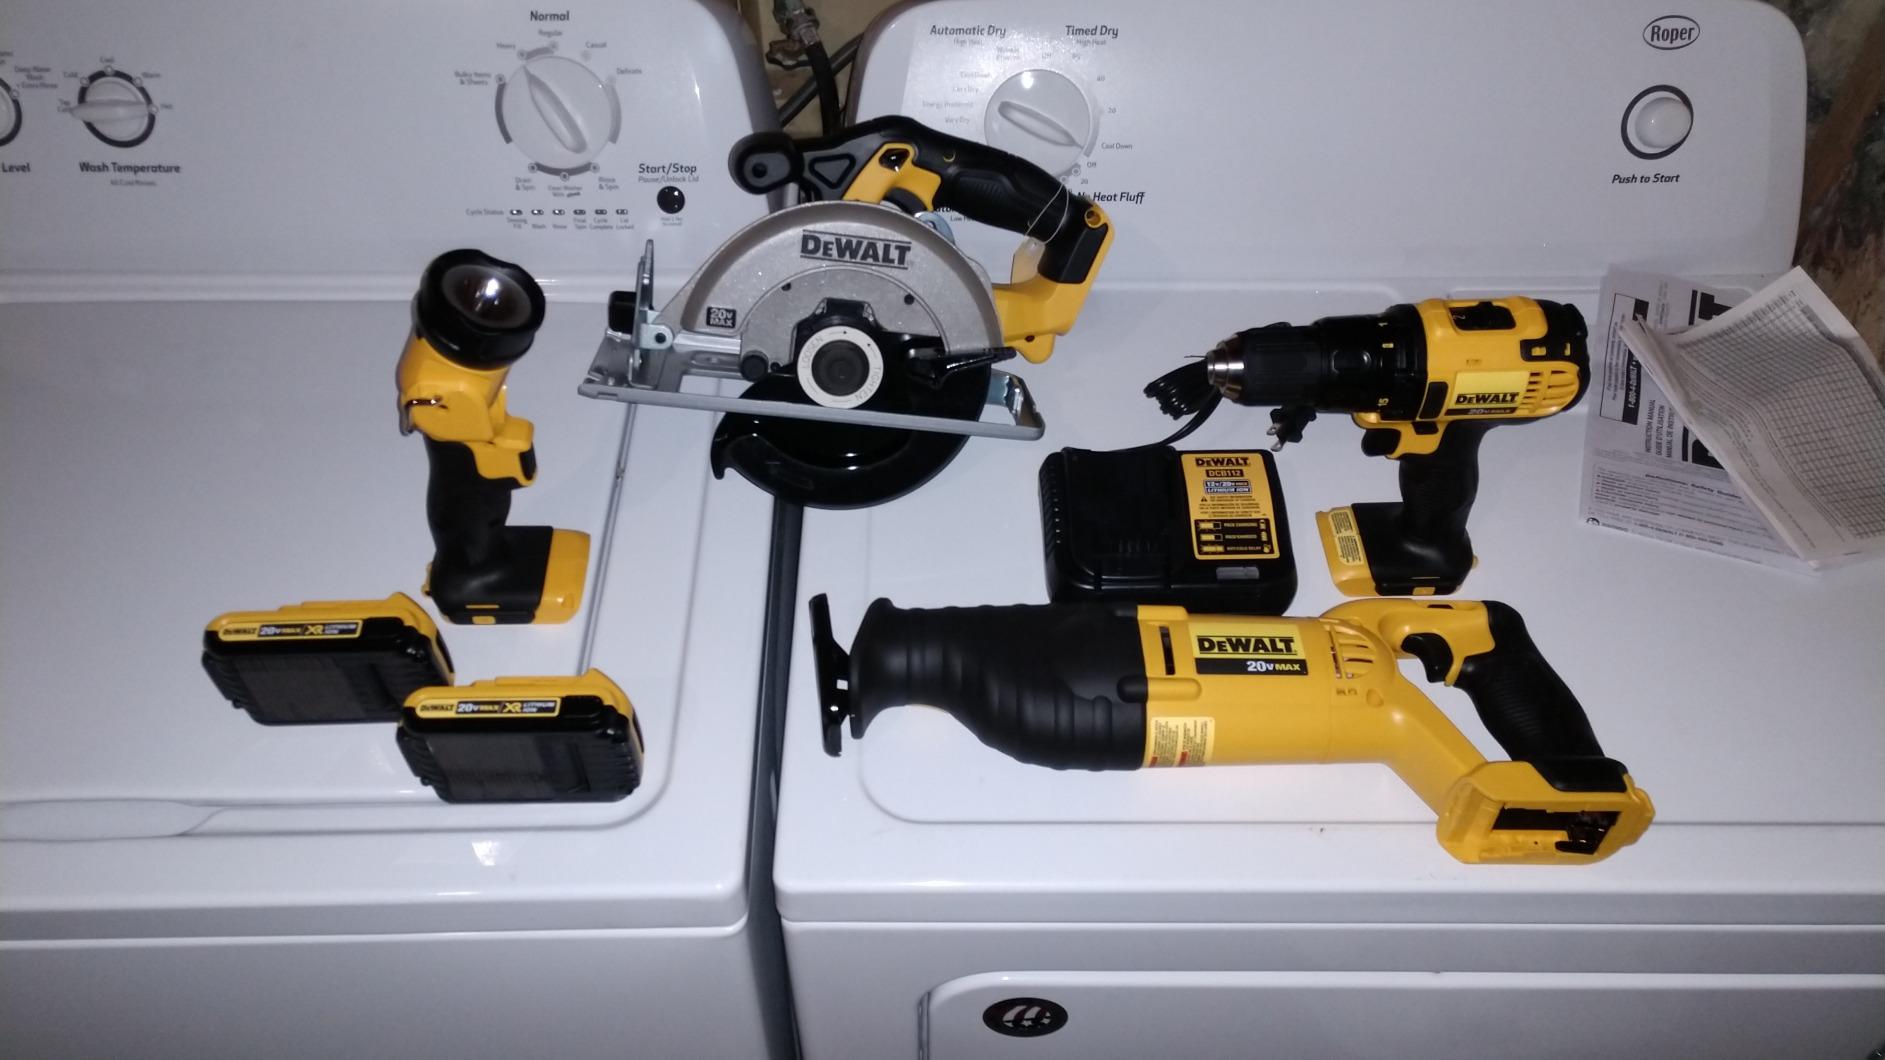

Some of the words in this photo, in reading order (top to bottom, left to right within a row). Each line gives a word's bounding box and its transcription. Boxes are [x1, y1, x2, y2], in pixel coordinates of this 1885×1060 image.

[530, 11, 570, 21] Normal
[538, 29, 563, 38] Regular
[929, 24, 985, 36] Automatic
[987, 25, 1006, 39] Dry
[1065, 24, 1098, 36] Timed
[1100, 25, 1119, 39] Dry
[1651, 25, 1695, 44] Roper
[585, 41, 608, 49] Casual
[616, 67, 642, 75] Delicate
[1101, 142, 1115, 150] Cool
[1115, 142, 1133, 150] Down
[2, 162, 31, 173] Level
[79, 162, 109, 173] Wash
[110, 162, 181, 175] Temperature
[638, 163, 697, 175] Start/Stop
[687, 175, 700, 183] Lid
[1611, 174, 1637, 184] Push
[1639, 174, 1650, 183] to
[1652, 173, 1680, 183] Start
[1093, 191, 1118, 202] Heat
[1119, 191, 1146, 205] Fluff
[710, 318, 733, 327] MAX
[801, 336, 823, 369] LOOSEN
[855, 367, 880, 400] TIGHTEN
[305, 624, 323, 635] XR
[1197, 637, 1296, 653] DEWALT
[503, 702, 521, 713] XR
